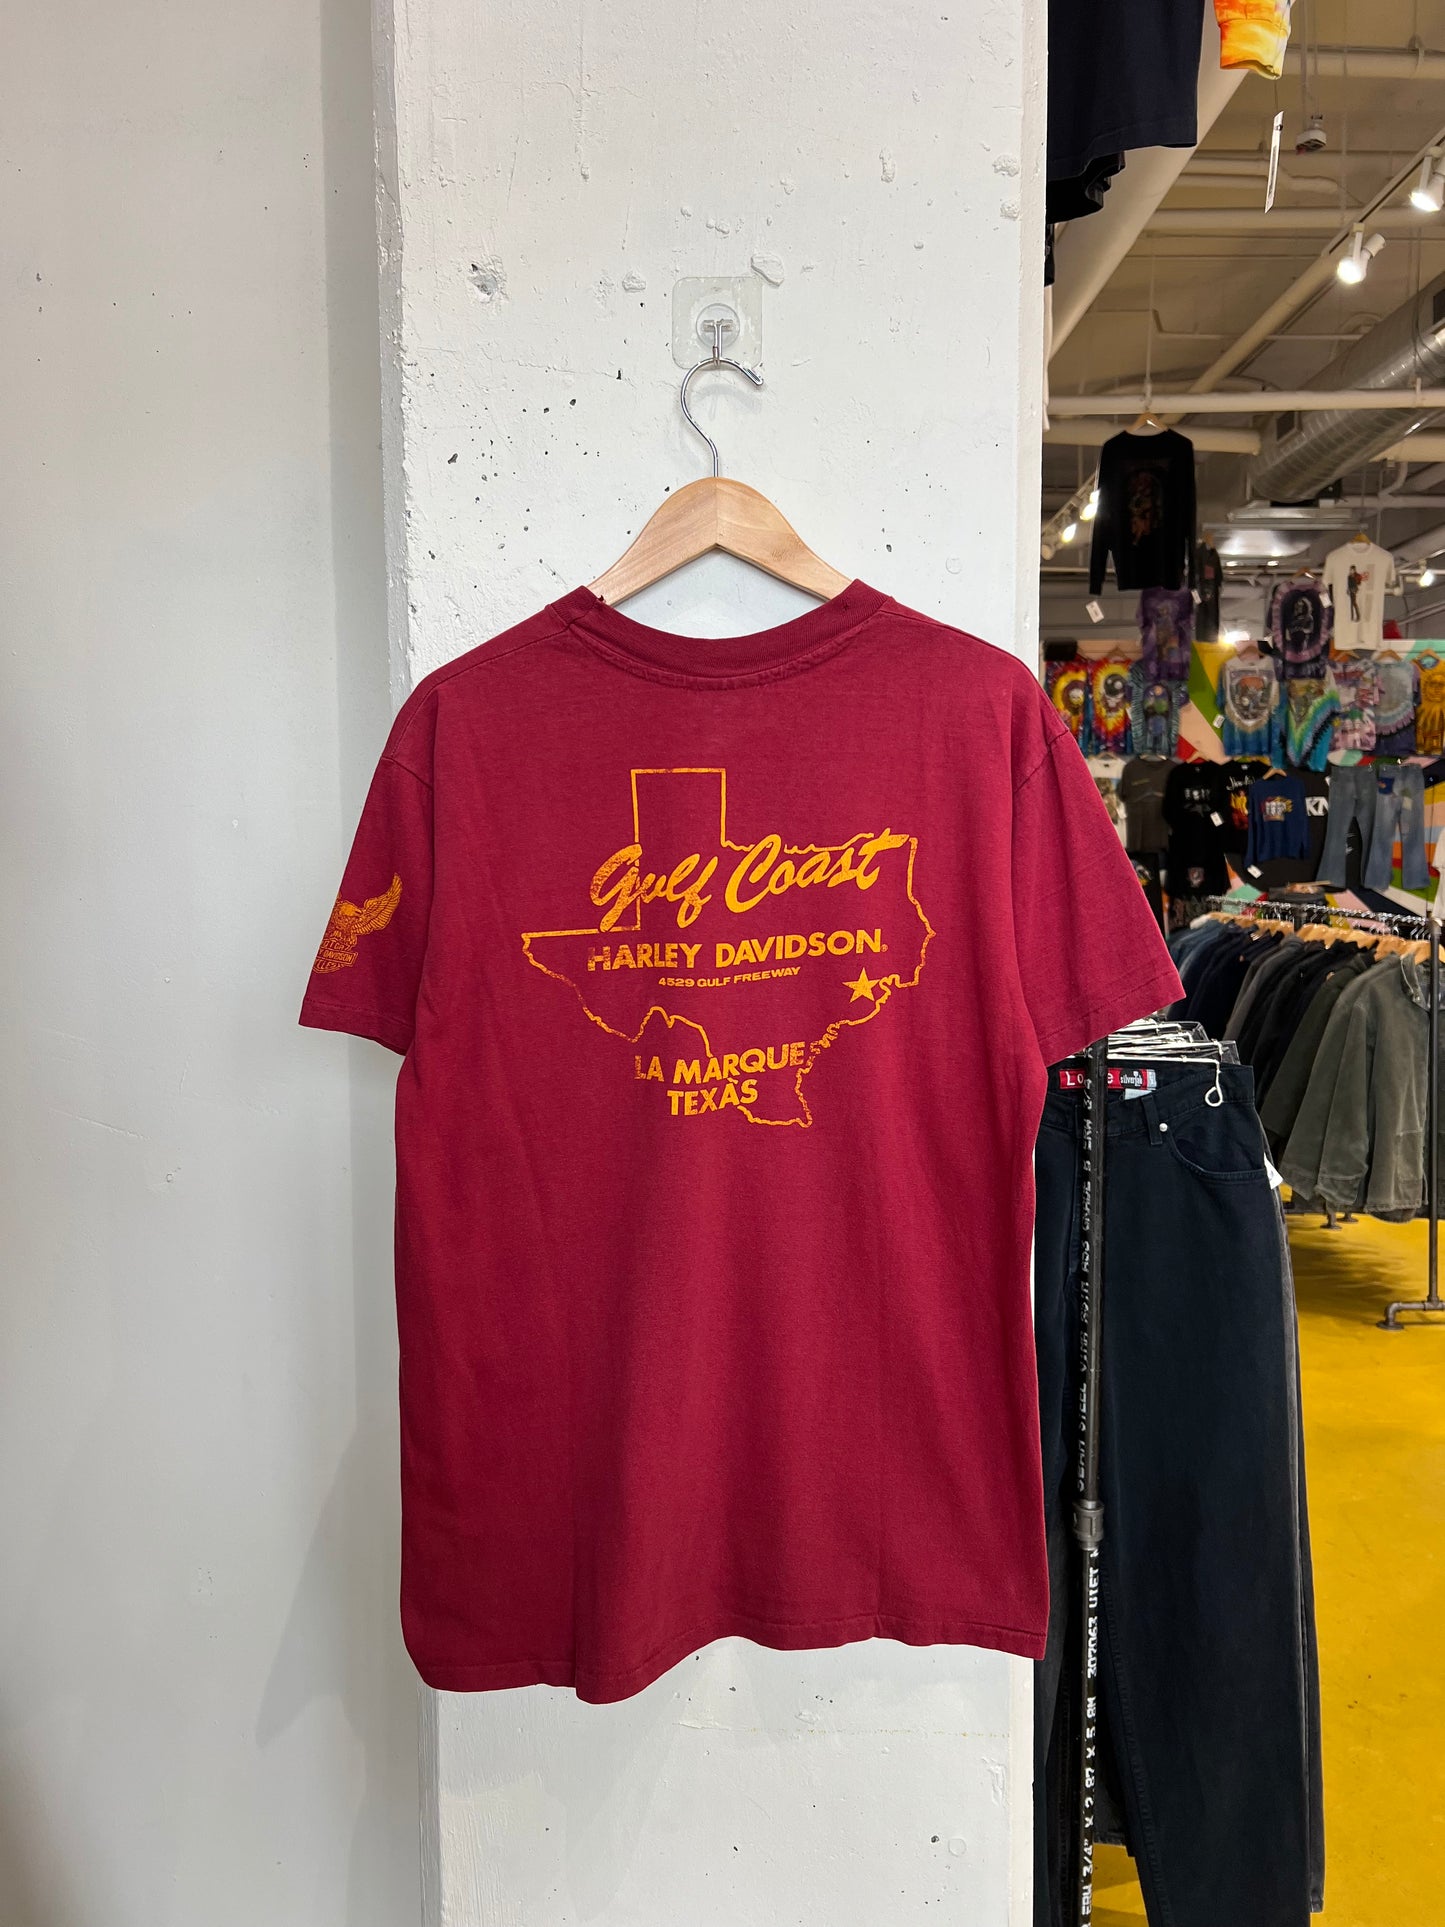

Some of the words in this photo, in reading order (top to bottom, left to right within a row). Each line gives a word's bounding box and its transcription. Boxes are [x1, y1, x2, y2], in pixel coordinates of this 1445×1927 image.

[589, 843, 719, 932] Gulf
[725, 828, 910, 913] Coast
[587, 943, 703, 972] HARLEY
[658, 977, 695, 988] 4529
[696, 976, 730, 988] GULF
[733, 966, 801, 984] FREEWAY
[634, 1055, 665, 1083] LA
[672, 1041, 806, 1085] MARQUE
[667, 1079, 758, 1116] TEXAS
